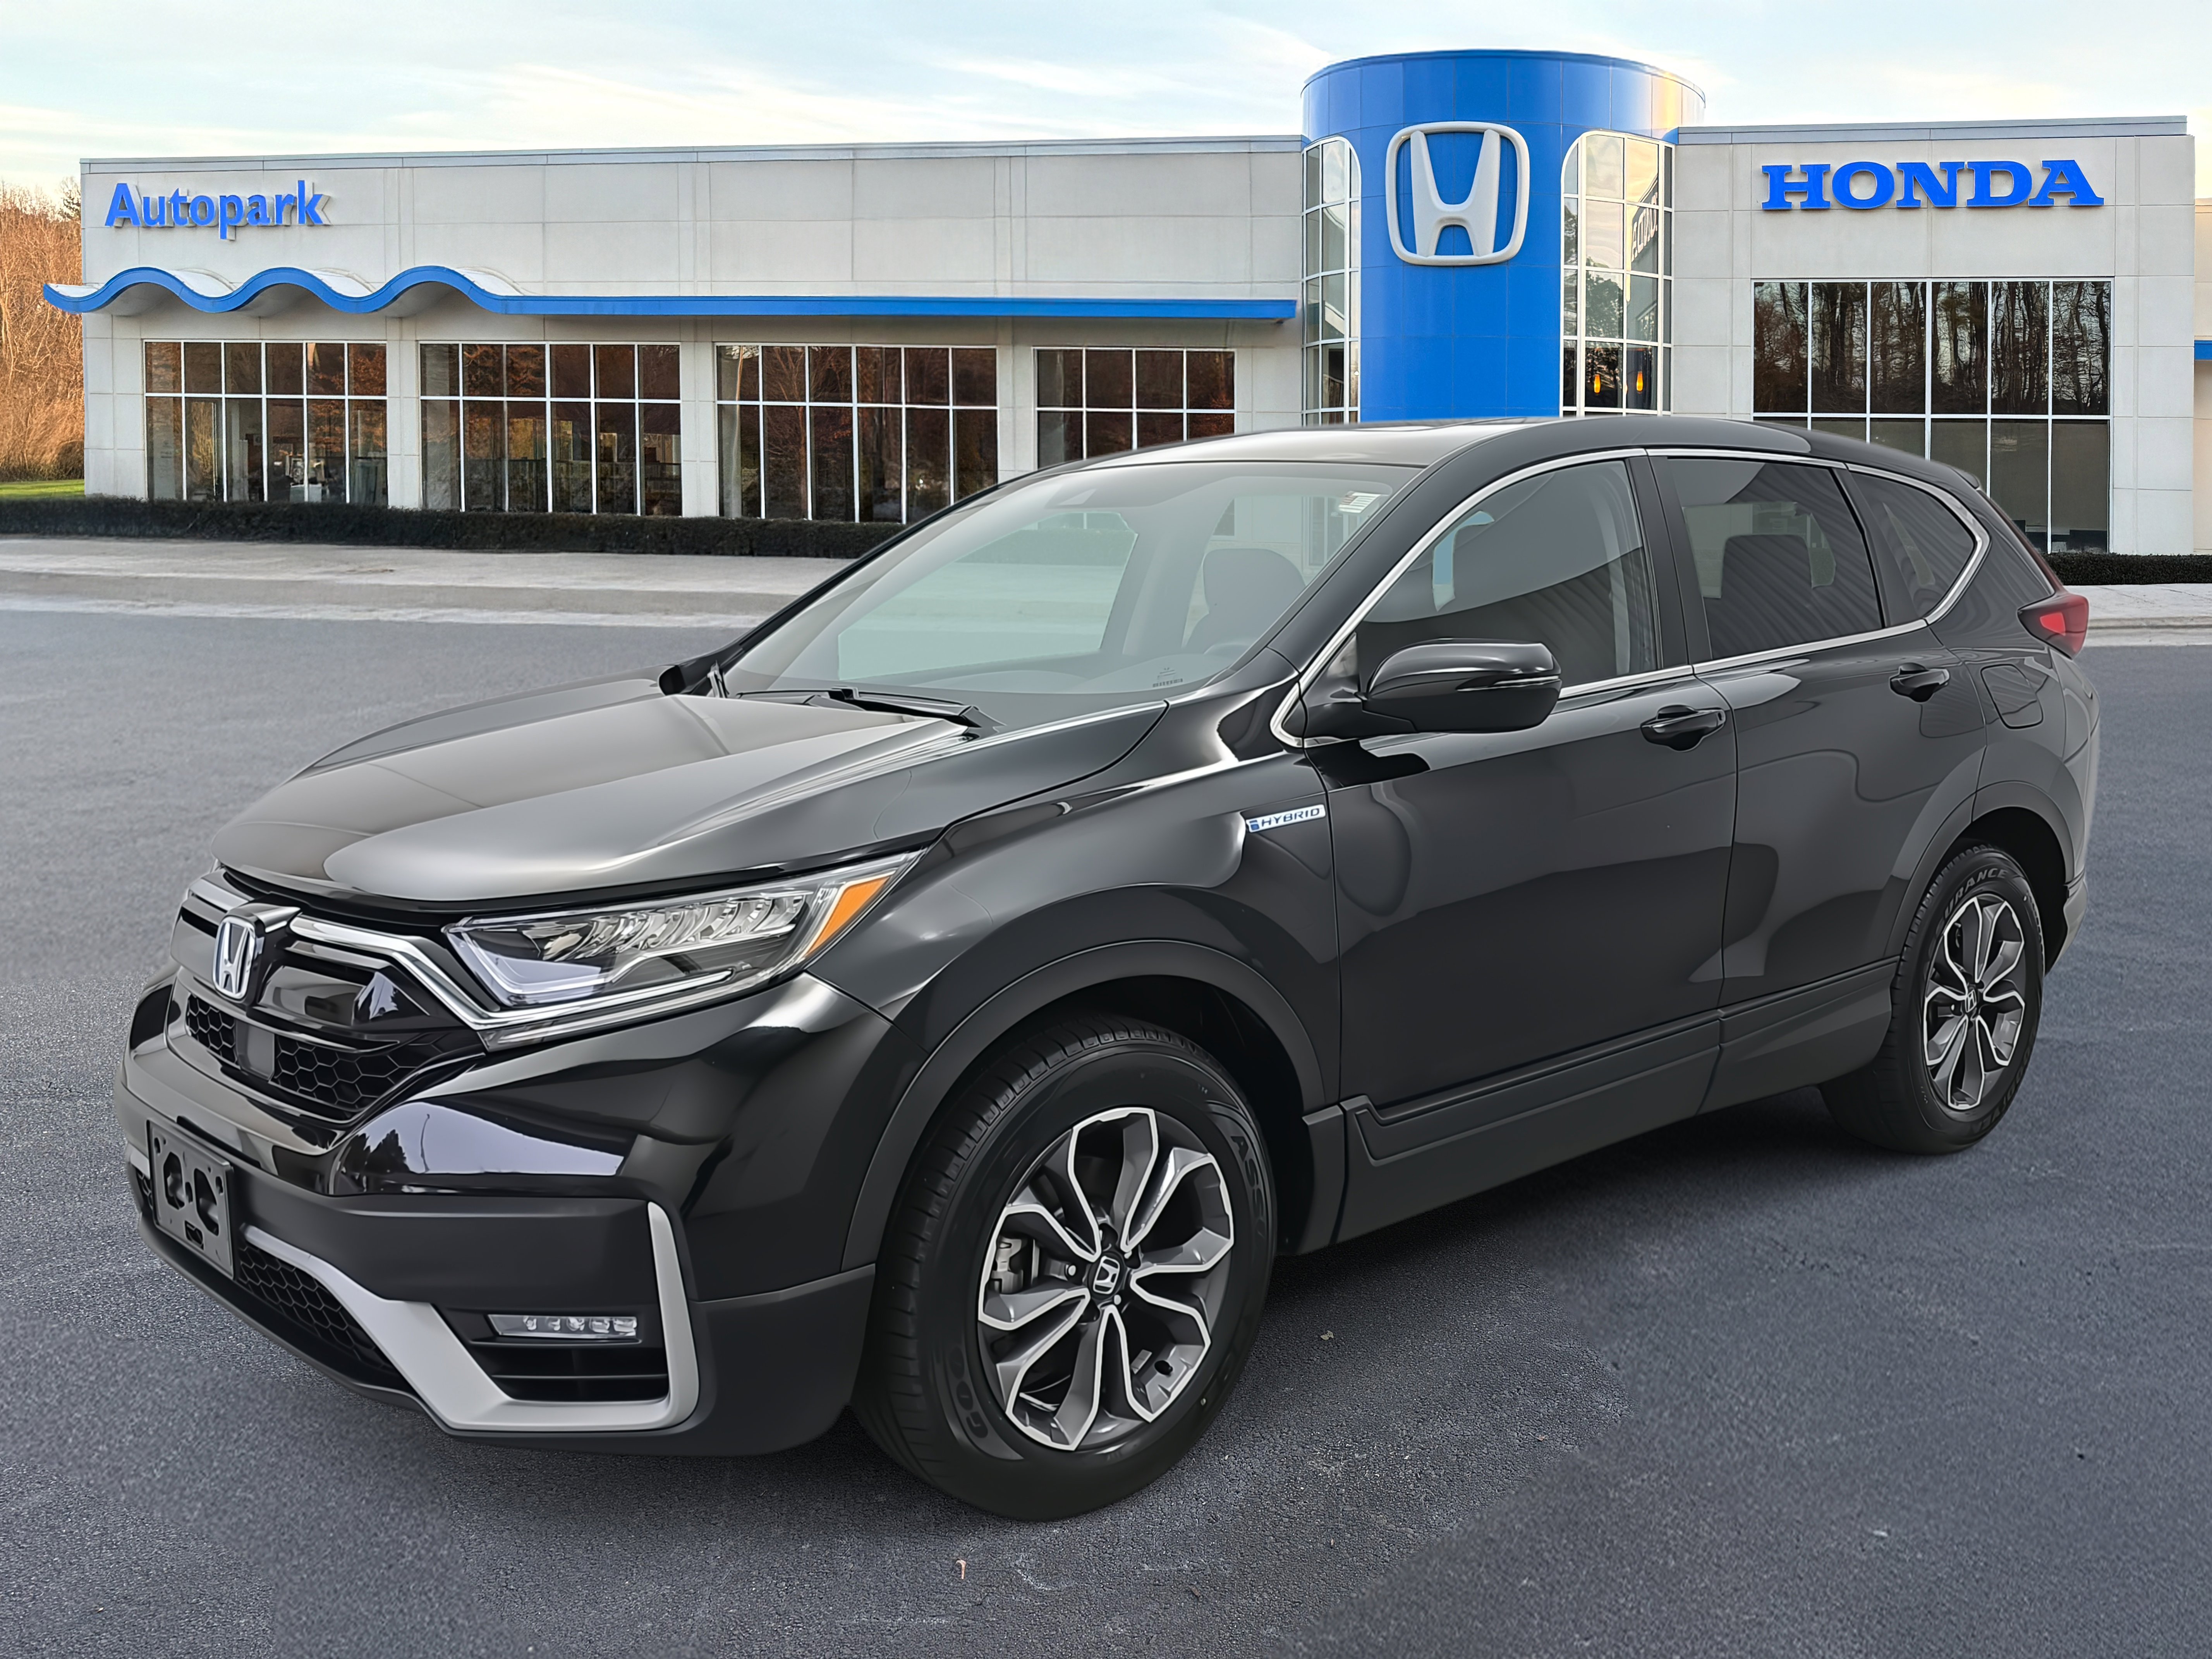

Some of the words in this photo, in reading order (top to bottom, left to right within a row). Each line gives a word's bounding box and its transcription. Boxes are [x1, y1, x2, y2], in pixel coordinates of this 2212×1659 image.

[104, 179, 328, 240] Autopark
[1761, 159, 2105, 210] HONDA
[1261, 808, 1320, 827] HYBRID
